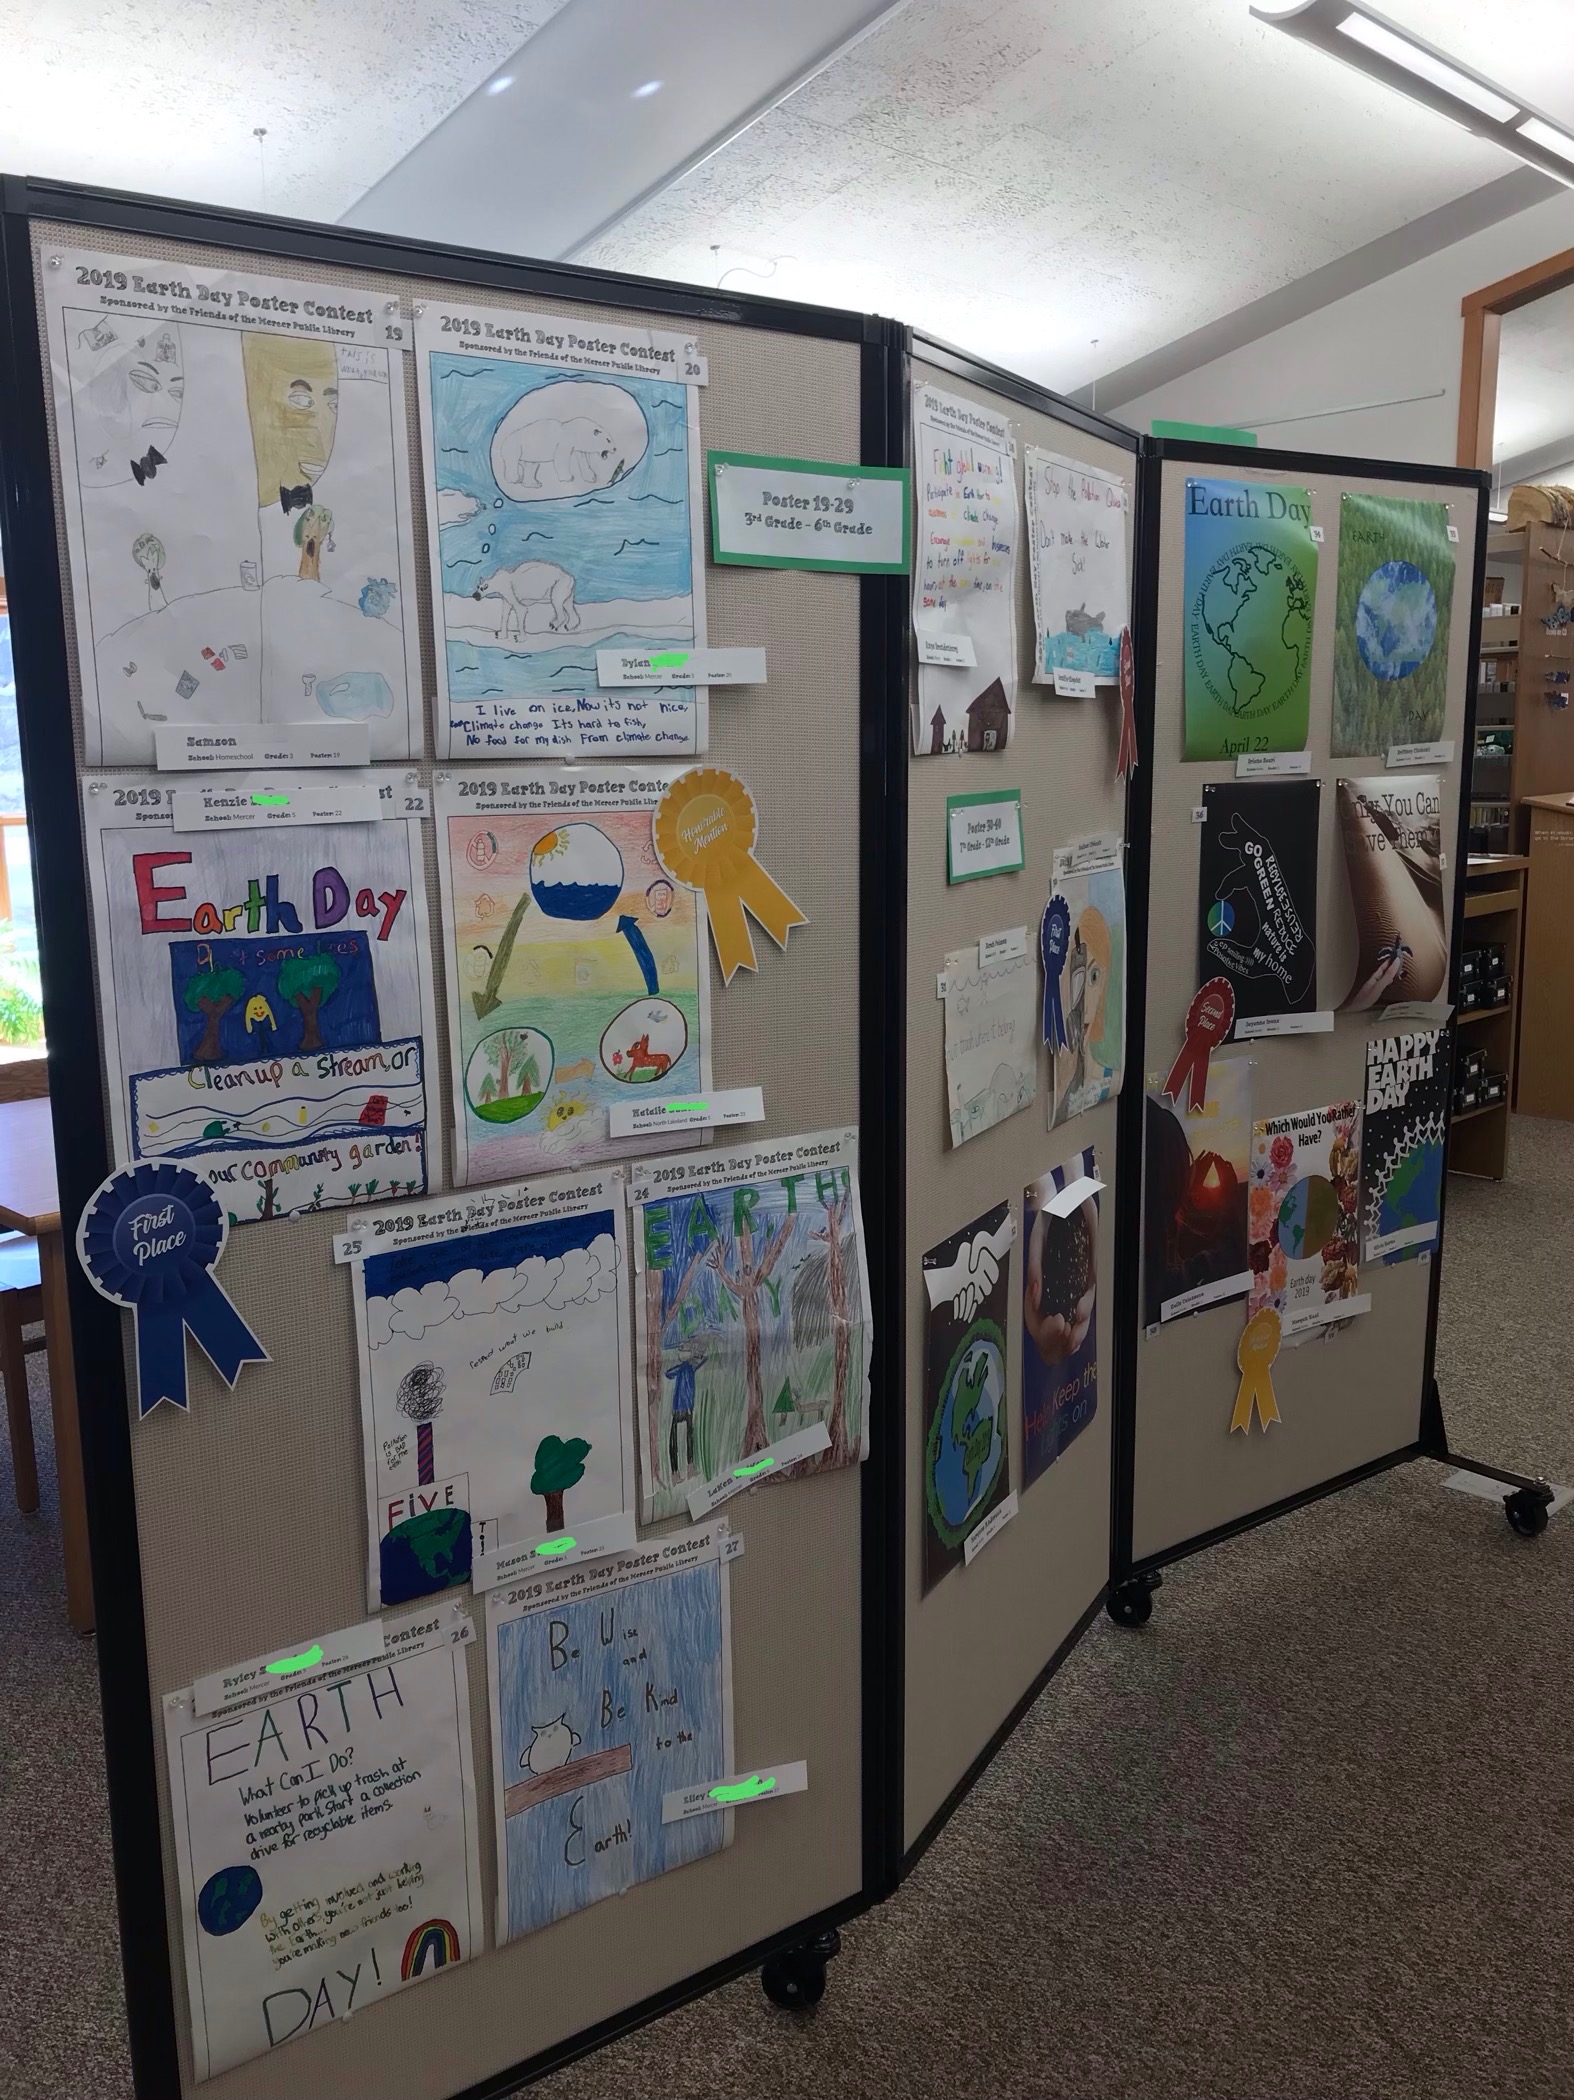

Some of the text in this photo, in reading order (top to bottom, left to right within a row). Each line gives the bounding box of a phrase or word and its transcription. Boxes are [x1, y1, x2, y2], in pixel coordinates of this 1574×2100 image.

[76, 267, 373, 324] 2019 Earth Day Poster Contest
[100, 296, 355, 338] Sponsored by the Friends of the Mercer Public Library
[385, 325, 403, 340] 19
[684, 362, 700, 376] 20
[762, 491, 854, 514] Poster 19-29
[1187, 486, 1311, 528] Earth Day
[744, 512, 873, 535] 3rd Grade 6th Grade
[1352, 530, 1385, 543] EARTH
[477, 705, 485, 716] I
[494, 704, 516, 715] live
[577, 698, 600, 711] Now
[628, 700, 648, 711] not
[1408, 710, 1429, 721] DAY
[463, 719, 504, 733] Climate
[509, 720, 543, 731] change
[579, 718, 602, 729] hard
[608, 719, 620, 728] to
[187, 736, 237, 747] Samson
[466, 732, 690, 747] No food for my dish From climate change
[1220, 736, 1269, 757] April 22
[215, 752, 253, 761] Homeschool
[113, 789, 162, 806] 2019
[204, 796, 248, 808] Kenzie
[405, 798, 424, 811] 22
[1381, 792, 1440, 816] You Can
[681, 806, 726, 843] Honorable
[967, 822, 985, 835] Poster
[693, 822, 729, 855] Mention
[967, 839, 982, 852] Grade
[995, 836, 1010, 847] Grade
[1245, 842, 1262, 857] GO
[1254, 857, 1275, 910] GREEN
[133, 851, 407, 941] Earth Day
[1262, 922, 1287, 962] nature is
[1273, 908, 1298, 955] REDUCE
[256, 947, 305, 966] some
[1253, 947, 1292, 984] my home
[1201, 1001, 1224, 1020] Second
[1198, 1015, 1216, 1031] Place
[1367, 1029, 1440, 1066] HAPPY
[292, 1062, 309, 1078] a
[391, 1047, 417, 1069] or
[1368, 1054, 1434, 1090] EARTH
[1366, 1082, 1410, 1115] DAY
[632, 1105, 667, 1118] Natalie
[1265, 1106, 1356, 1136] Which Would You Rather
[1298, 1130, 1322, 1147] Have?
[208, 1131, 422, 1184] our community garden!
[634, 1188, 649, 1201] 24
[373, 1183, 603, 1236] 2019 Earth Day Poster Contest
[128, 1204, 175, 1241] First
[133, 1231, 186, 1267] Place
[342, 1241, 362, 1256] 25
[1290, 1274, 1316, 1288] Earth day
[1294, 1286, 1310, 1298] 2019
[1052, 1378, 1080, 1415] Keep
[1084, 1362, 1097, 1388] the
[1072, 1400, 1087, 1423] on
[725, 1541, 739, 1555] 27
[451, 1627, 469, 1643] 26
[550, 1608, 638, 1671] Be Wise
[622, 1648, 647, 1666] and
[600, 1682, 678, 1728] Be Kind
[206, 1666, 404, 1786] EARTH
[656, 1731, 693, 1749] to the
[238, 1747, 354, 1806] What Can I Do?
[244, 1756, 406, 1826] Volunteer to pick up trash at
[246, 1832, 257, 1845] a
[260, 1818, 295, 1839] nearby
[326, 1797, 354, 1816] Start
[360, 1790, 370, 1801] a
[250, 1842, 279, 1861] drive
[282, 1832, 299, 1846] for
[302, 1813, 357, 1841] recyclable
[564, 1796, 632, 1866] Earth!
[263, 1948, 382, 2048] DAY!
